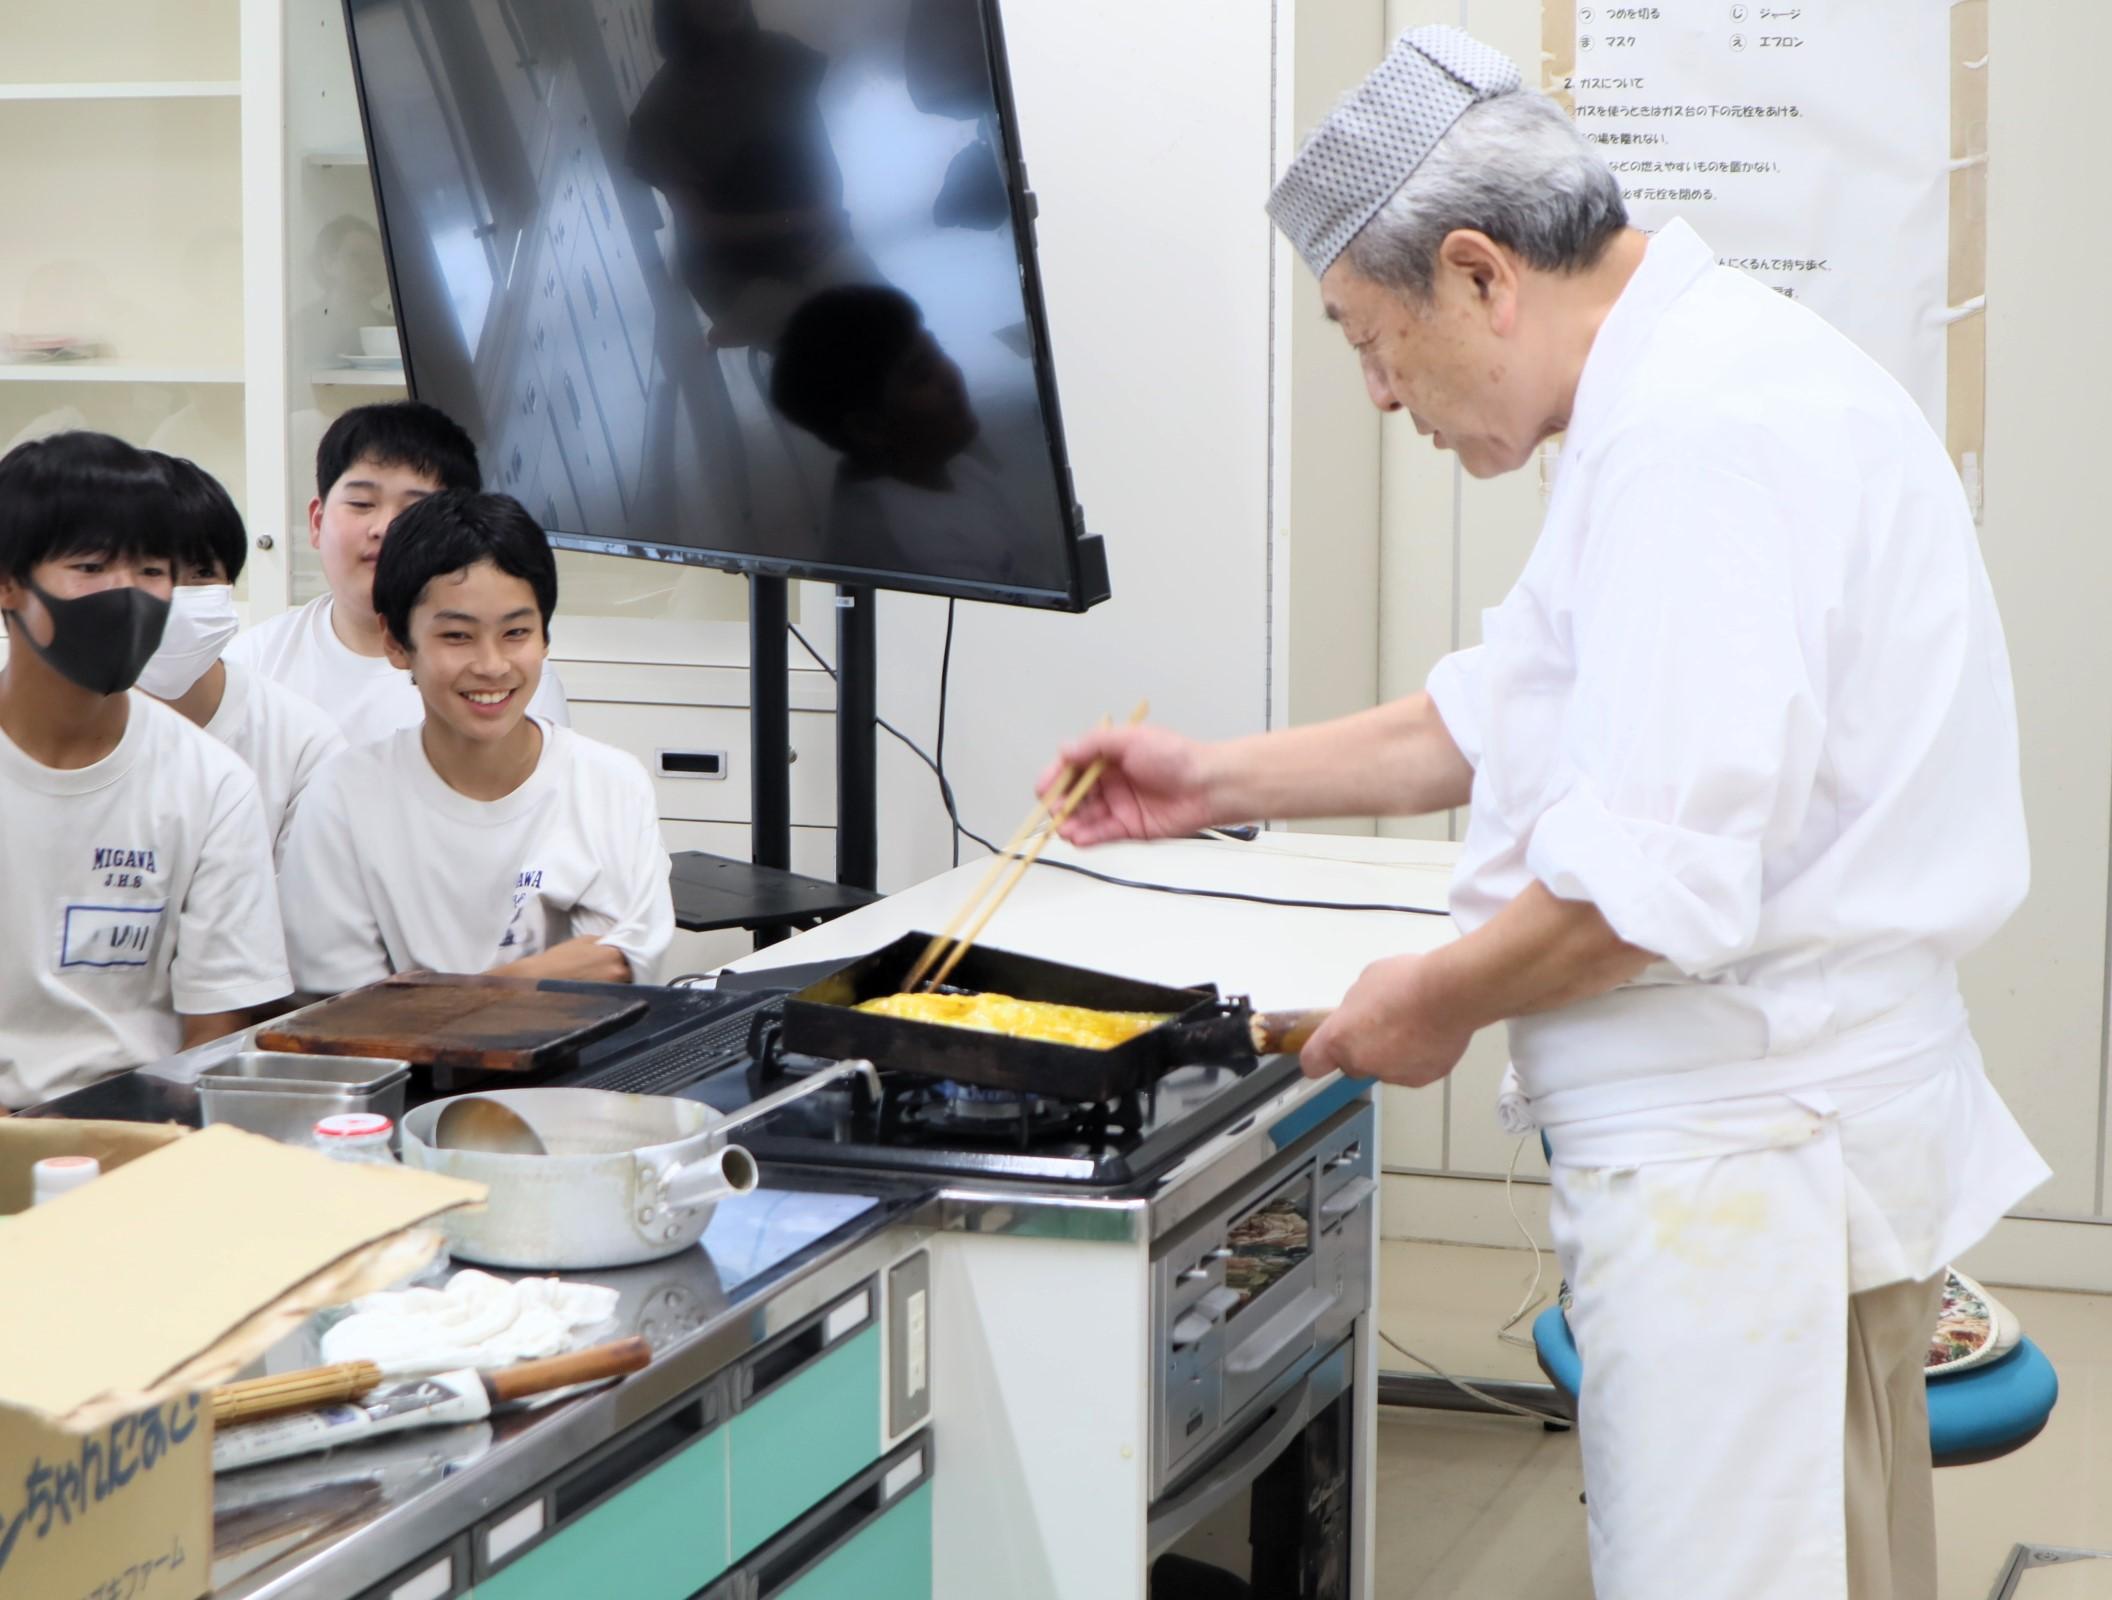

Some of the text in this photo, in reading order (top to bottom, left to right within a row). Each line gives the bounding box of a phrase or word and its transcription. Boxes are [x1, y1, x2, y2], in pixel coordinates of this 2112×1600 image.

[1605, 7, 1661, 20] つめを切る
[1605, 36, 1637, 48] マスク
[1580, 77, 1645, 89] ガスについて
[1582, 132, 1669, 145] の場を離れない。
[92, 847, 156, 874] MIGAWA
